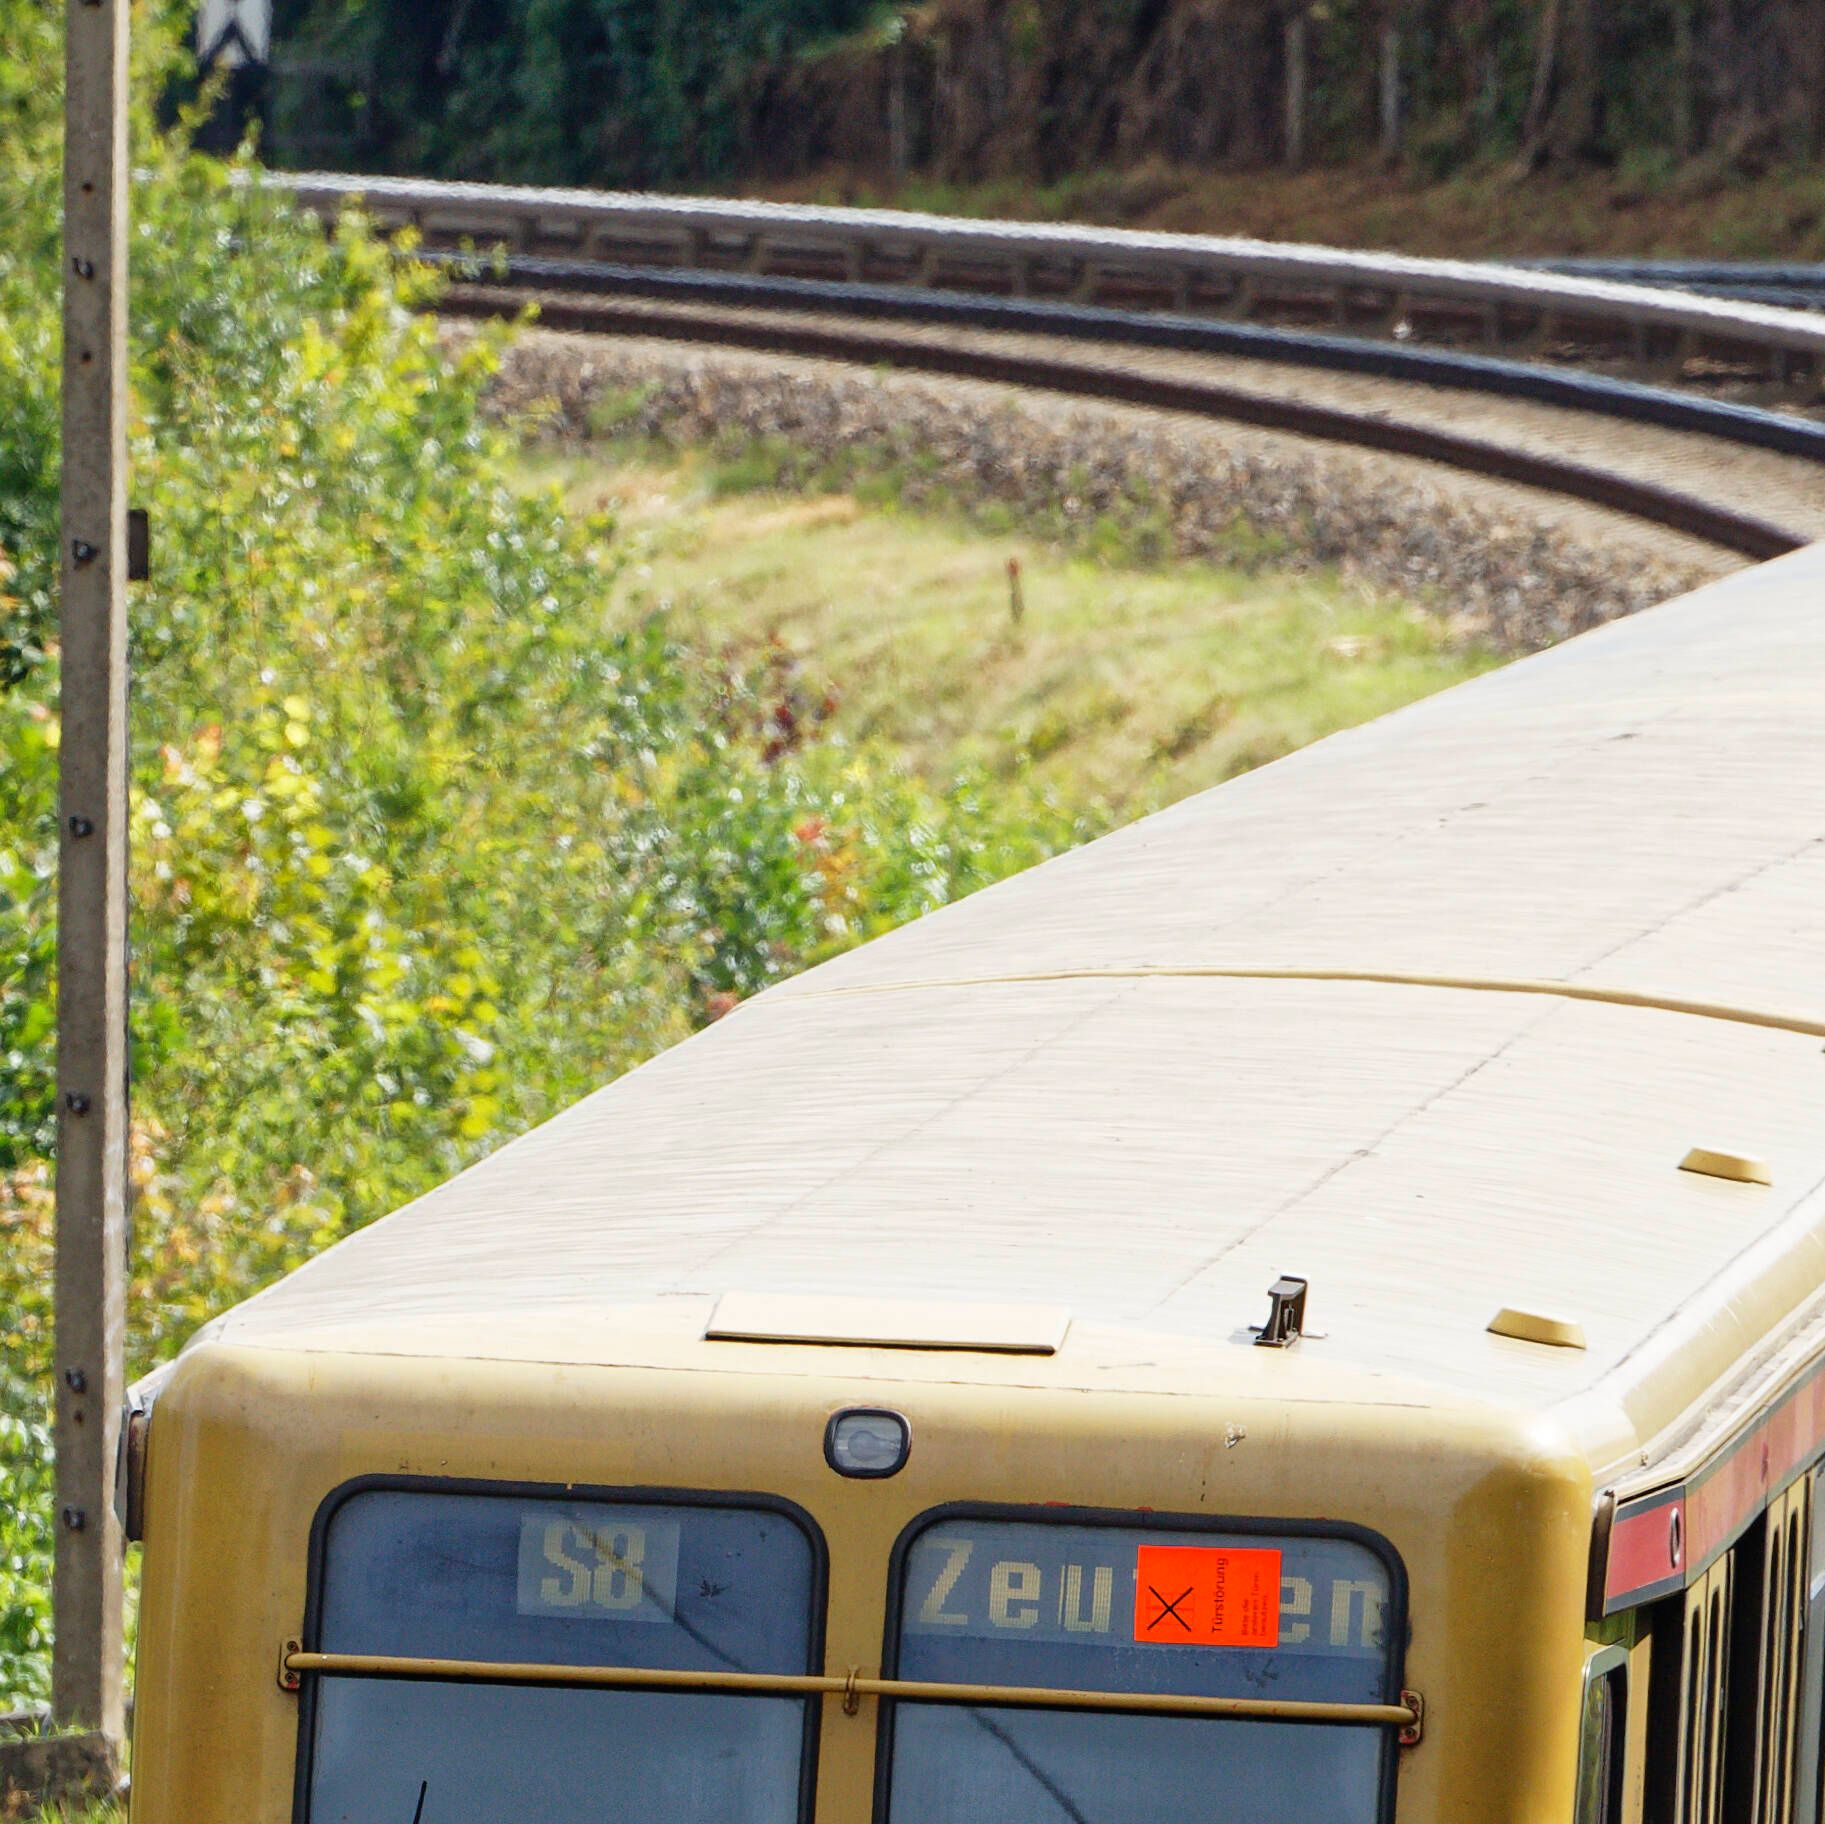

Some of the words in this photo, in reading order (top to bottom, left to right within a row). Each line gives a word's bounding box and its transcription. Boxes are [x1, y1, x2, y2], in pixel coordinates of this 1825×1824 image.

[540, 1518, 646, 1610] S8
[919, 1538, 1383, 1648] Zeuen
[1211, 1557, 1229, 1634] Türstörung
